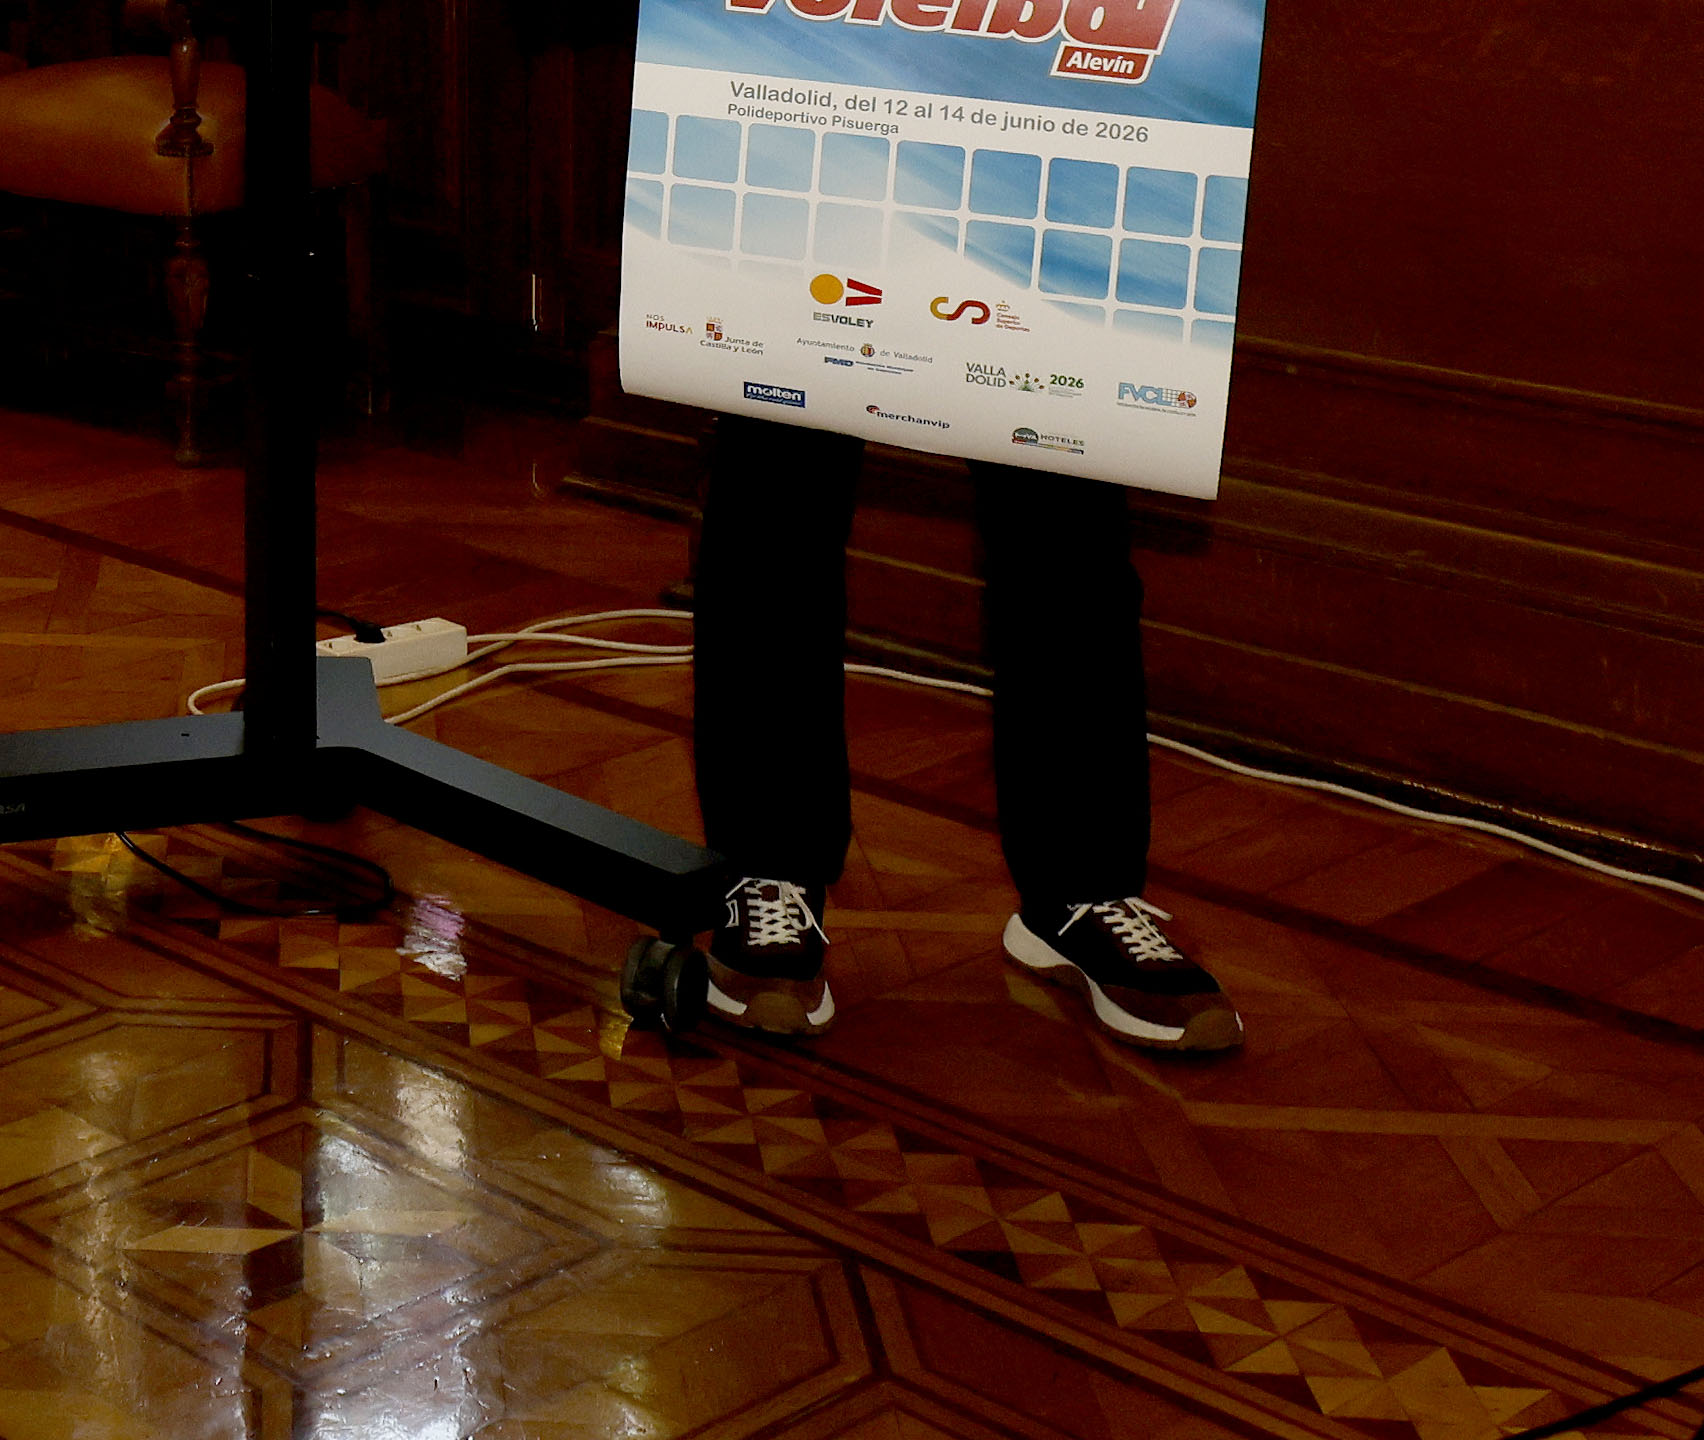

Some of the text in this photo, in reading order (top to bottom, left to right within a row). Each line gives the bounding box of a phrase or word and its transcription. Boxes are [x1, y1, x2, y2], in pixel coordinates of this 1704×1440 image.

[1065, 49, 1135, 75] Alevín
[730, 80, 1149, 142] Valladolid, del 12 al 14 de junio de 2026
[727, 103, 899, 136] Polideportivo Pisuerga
[646, 320, 693, 334] IMPULSA
[813, 312, 874, 328] ESVOLEY
[699, 339, 731, 350] Castilla
[741, 345, 763, 355] León
[724, 336, 764, 348] Junta de
[796, 337, 933, 363] Ayuntamiento de Valladolid
[966, 362, 1006, 378] VALLA
[966, 373, 1007, 388] DOLID
[1049, 374, 1084, 389] 2026
[747, 384, 803, 401] molten
[877, 410, 951, 429] merchanvip
[1040, 433, 1085, 446] HOTELES
